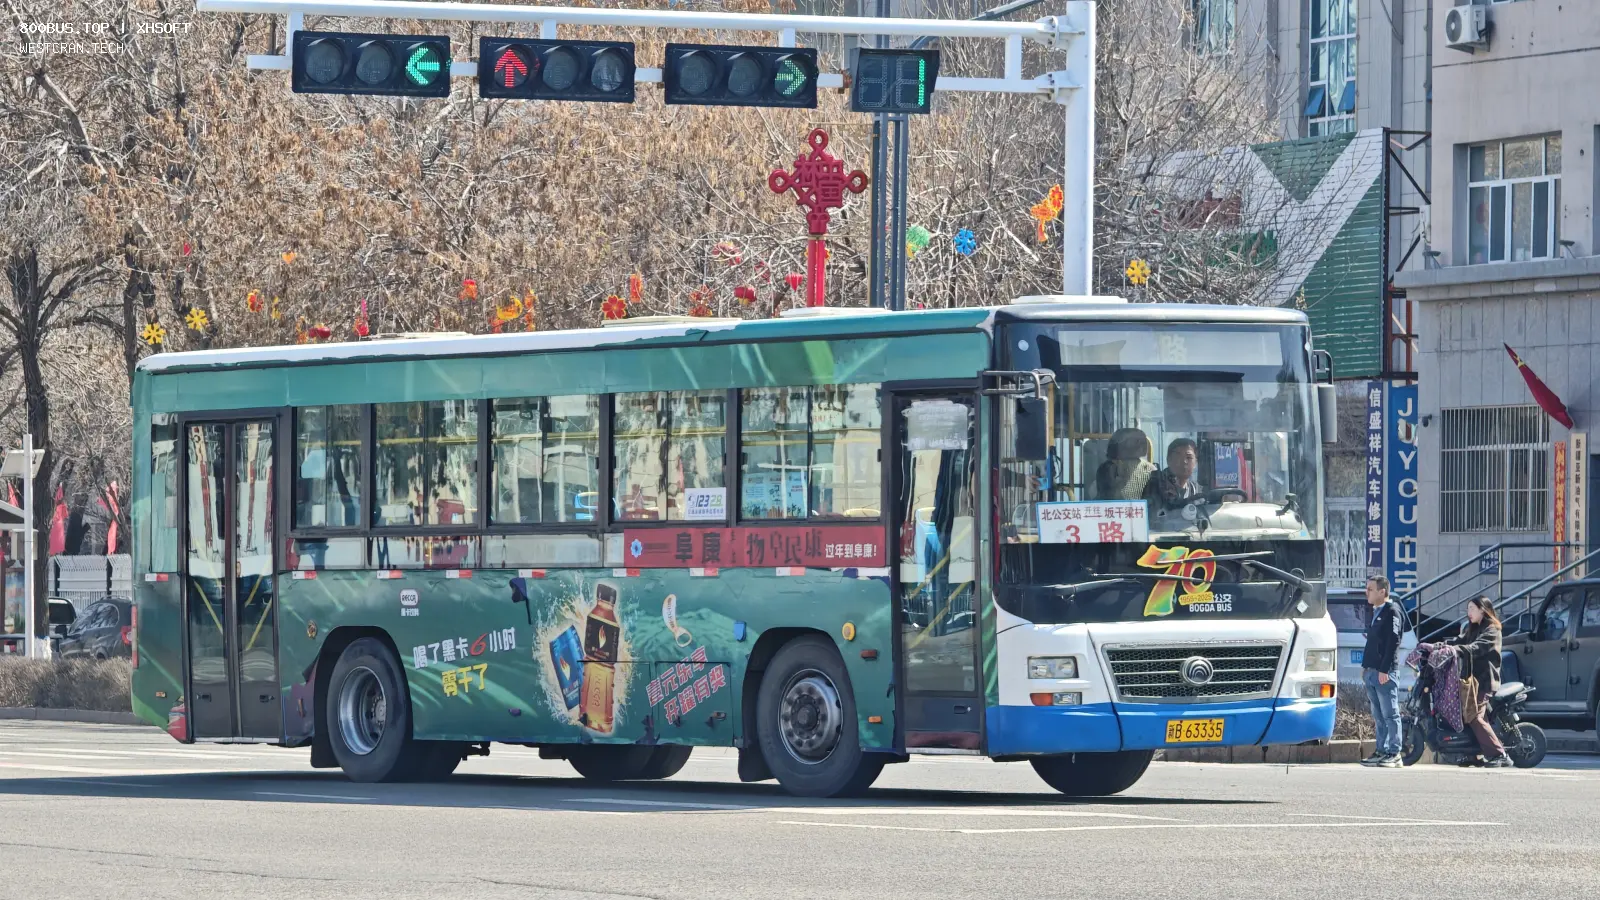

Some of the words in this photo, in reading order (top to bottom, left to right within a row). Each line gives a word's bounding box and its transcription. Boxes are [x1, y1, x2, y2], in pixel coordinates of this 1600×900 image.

[1367, 388, 1382, 565] 信盛祥汽车修理厂
[1041, 508, 1082, 521] 北公交站
[1065, 524, 1081, 543] 3
[1098, 521, 1124, 543] 路
[1189, 603, 1215, 613] BOGDA
[1216, 603, 1233, 612] BUS
[663, 663, 727, 725] 开罐有奖
